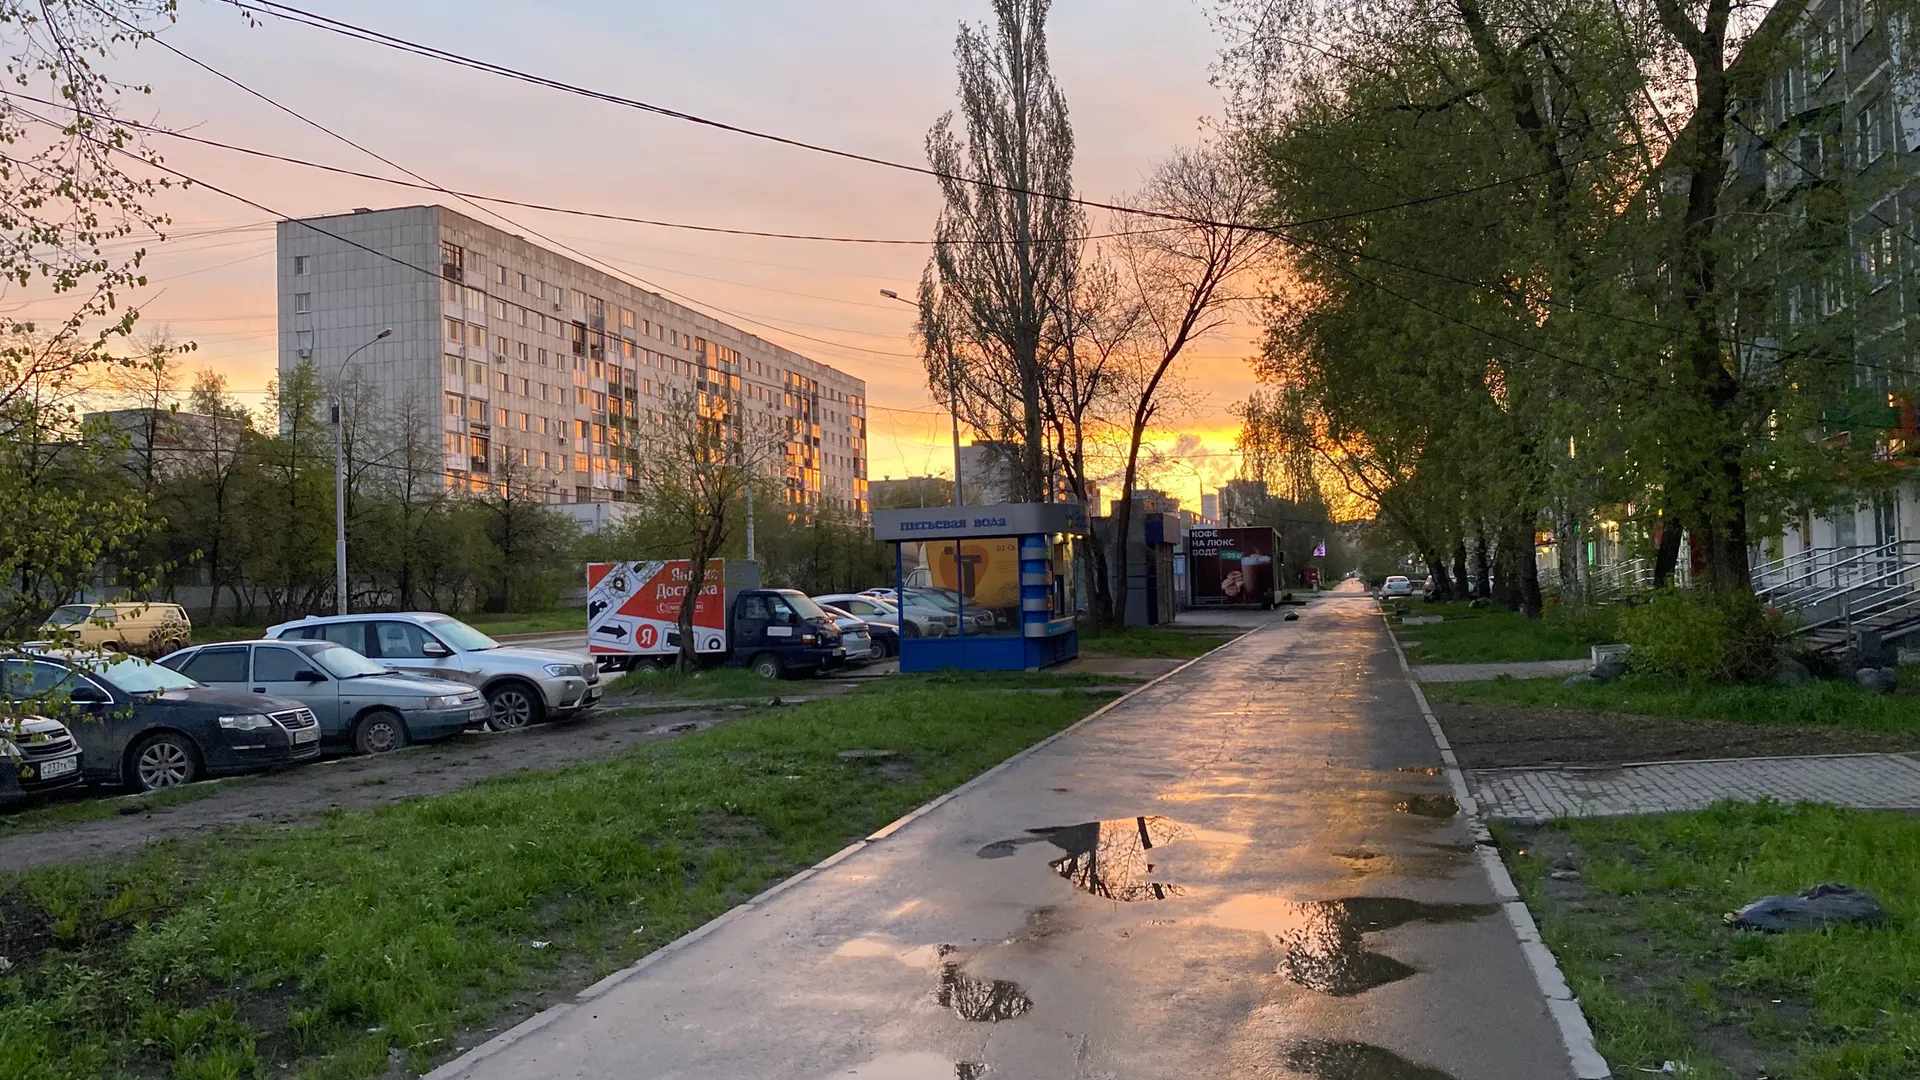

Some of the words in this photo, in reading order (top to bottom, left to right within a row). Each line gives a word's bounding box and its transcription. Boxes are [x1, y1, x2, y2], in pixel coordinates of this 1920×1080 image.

[900, 519, 967, 531] питьевая
[973, 517, 1007, 528] вода
[1191, 530, 1218, 538] КОФЕ
[1206, 539, 1235, 547] ЛЮКС
[1192, 549, 1218, 557] ВОДЕ
[640, 628, 653, 645] Я
